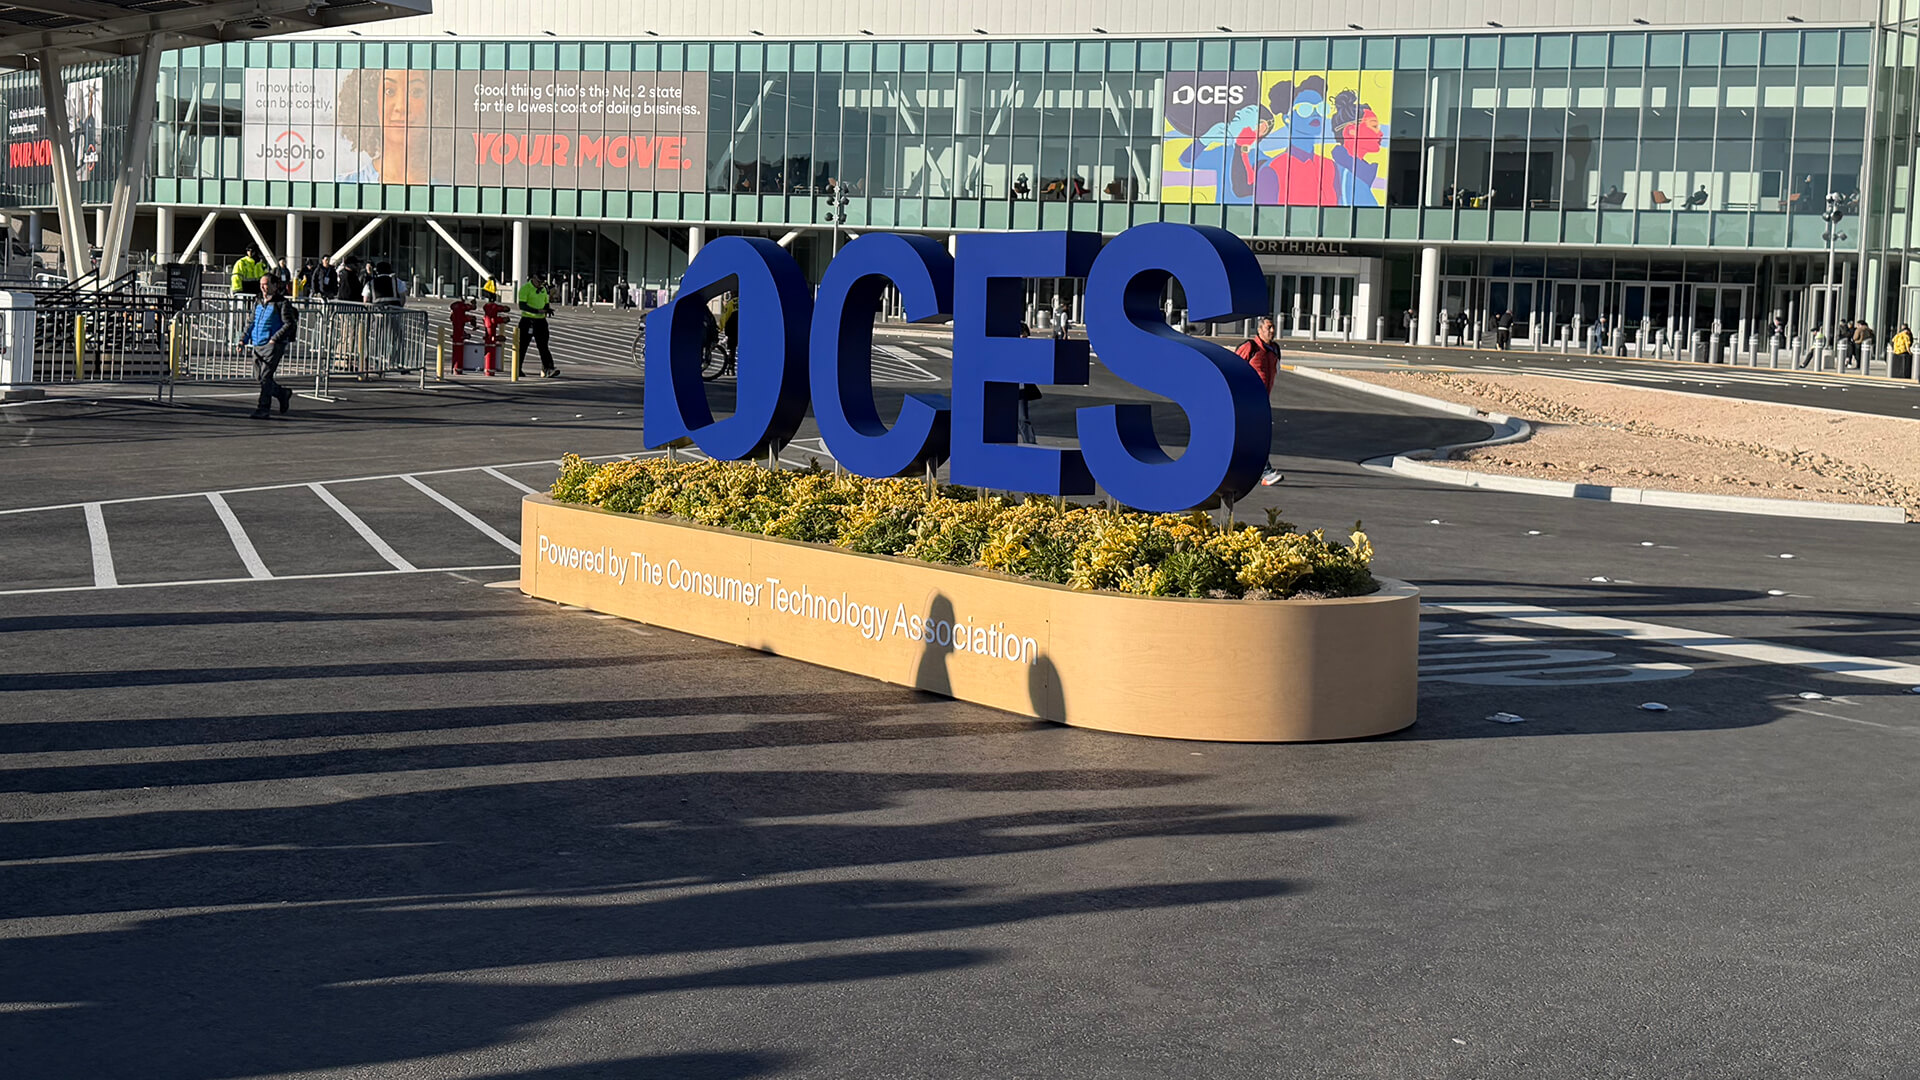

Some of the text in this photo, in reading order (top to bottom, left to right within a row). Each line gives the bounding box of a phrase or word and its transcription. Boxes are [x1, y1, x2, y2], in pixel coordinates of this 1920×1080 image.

[256, 81, 316, 94] Innovation
[474, 83, 682, 100] Good thing Ohio's the No. 2 state
[255, 97, 333, 112] can be costly.
[473, 99, 701, 118] for the lowest cost of doing business.
[10, 142, 34, 168] YOUR
[33, 139, 53, 167] MOV
[256, 143, 325, 160] JobsOhio
[472, 132, 692, 170] YOUR MOVE.
[1244, 240, 1348, 254] NORTH HALL
[539, 534, 1038, 665] Powered by The Consumer Technology Association
